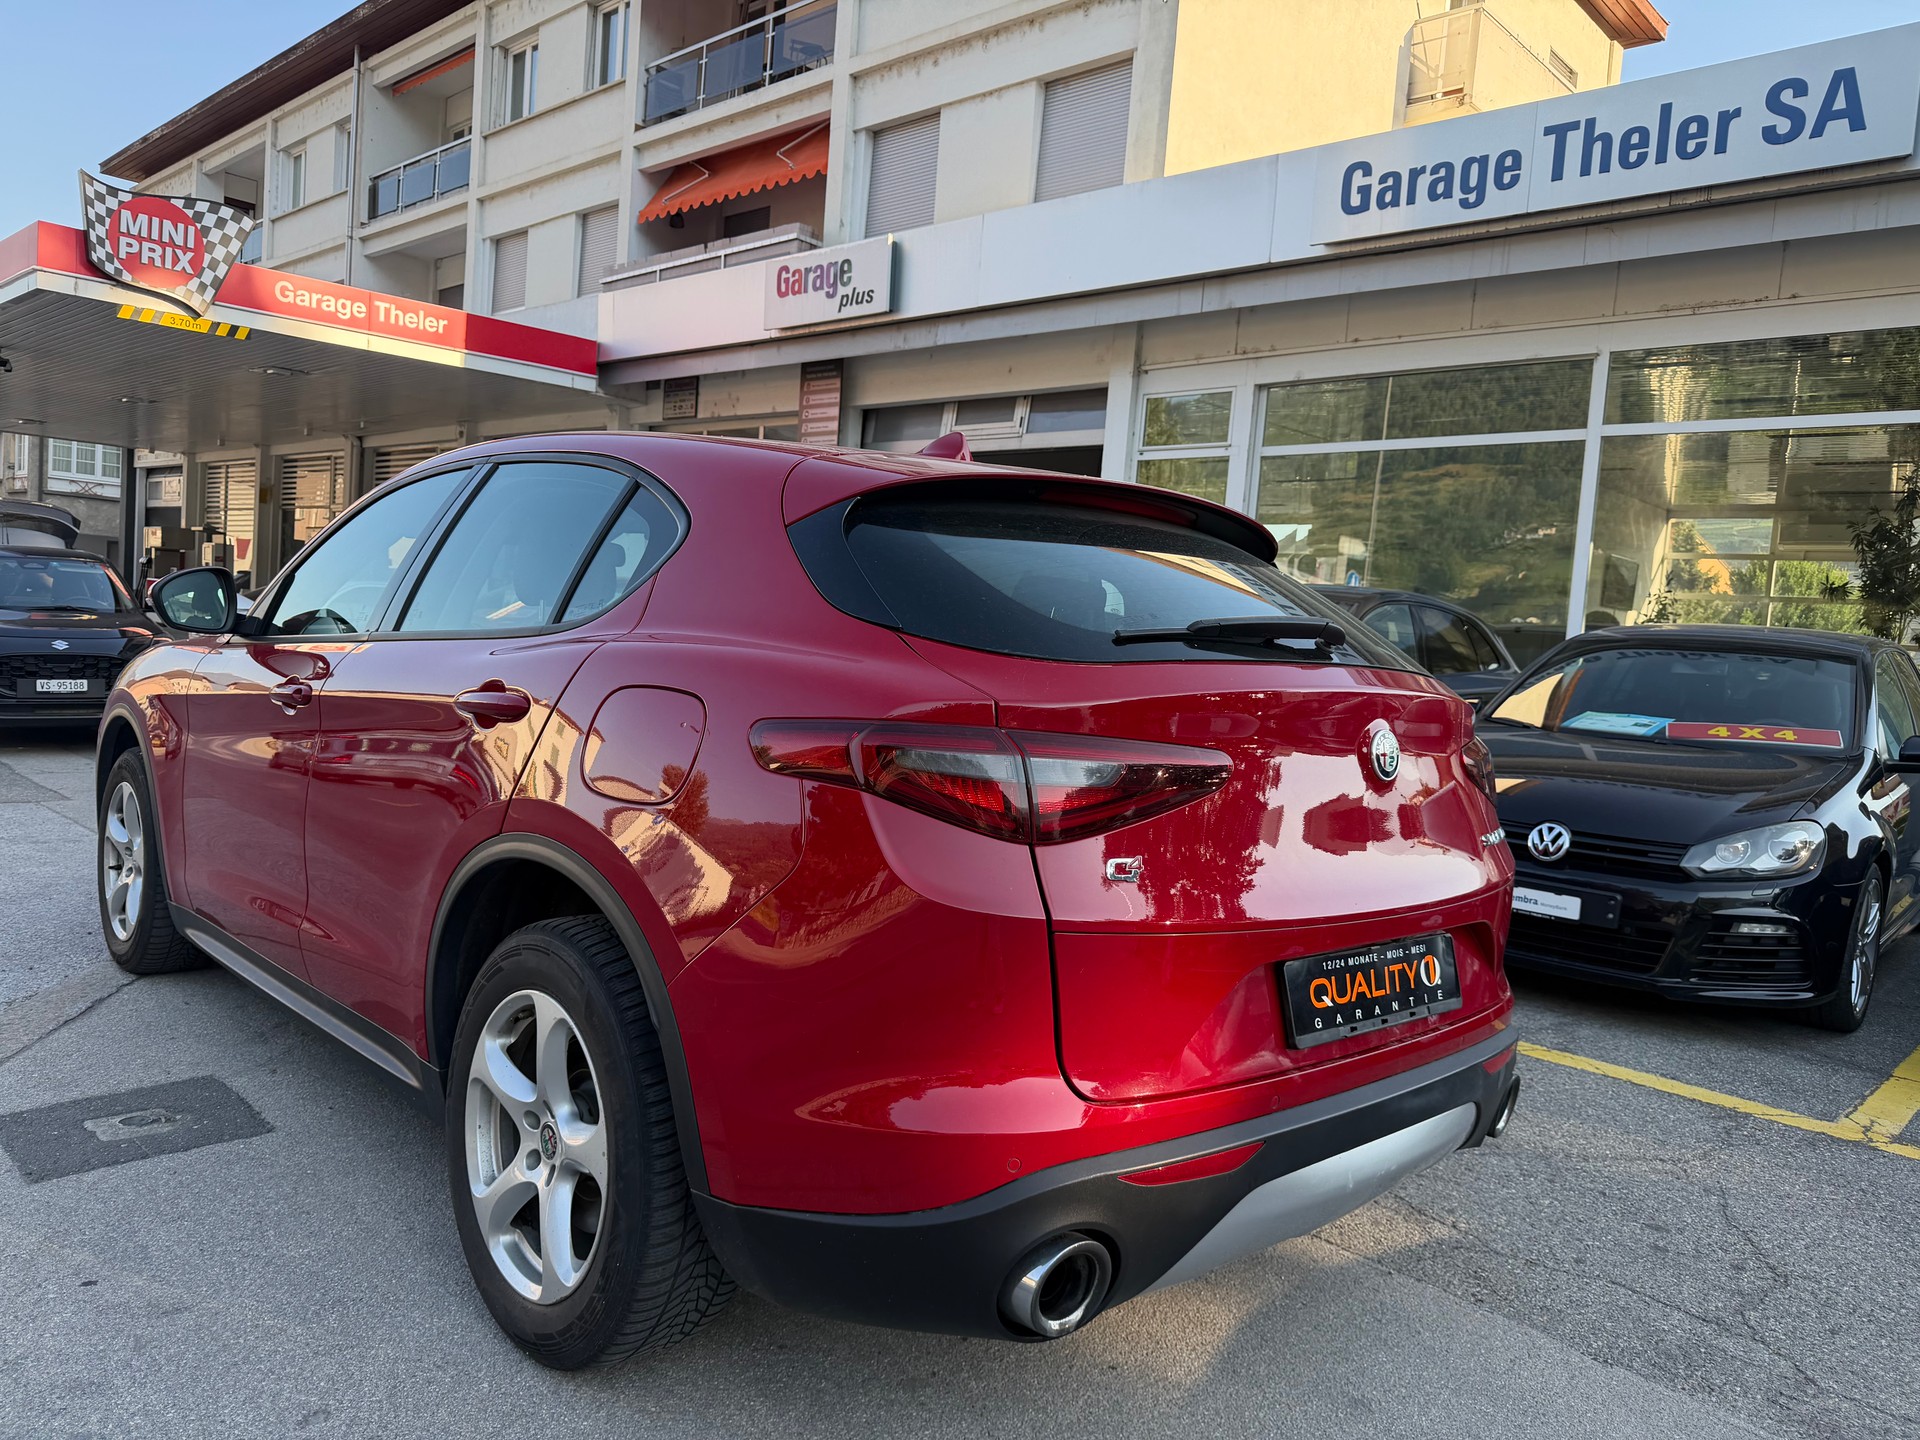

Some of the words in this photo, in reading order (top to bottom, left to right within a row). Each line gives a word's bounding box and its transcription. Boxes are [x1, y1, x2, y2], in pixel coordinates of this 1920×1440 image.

[1340, 147, 1522, 216] Garage
[1543, 102, 1742, 182] Theler
[1762, 67, 1867, 145] SA
[119, 209, 196, 250] MINI
[118, 236, 195, 275] PRIX
[777, 259, 852, 299] Garage
[274, 280, 367, 320] Garage
[373, 301, 448, 334] Theler
[838, 287, 875, 313] plus
[1105, 855, 1144, 883] Q4
[1322, 961, 1345, 970] 12/24
[1347, 953, 1378, 967] MONATE
[1386, 948, 1404, 959] MOIS
[1411, 944, 1426, 954] MESI
[1310, 960, 1418, 1009] QUALITY
[1314, 989, 1444, 1029] GARANTIE
